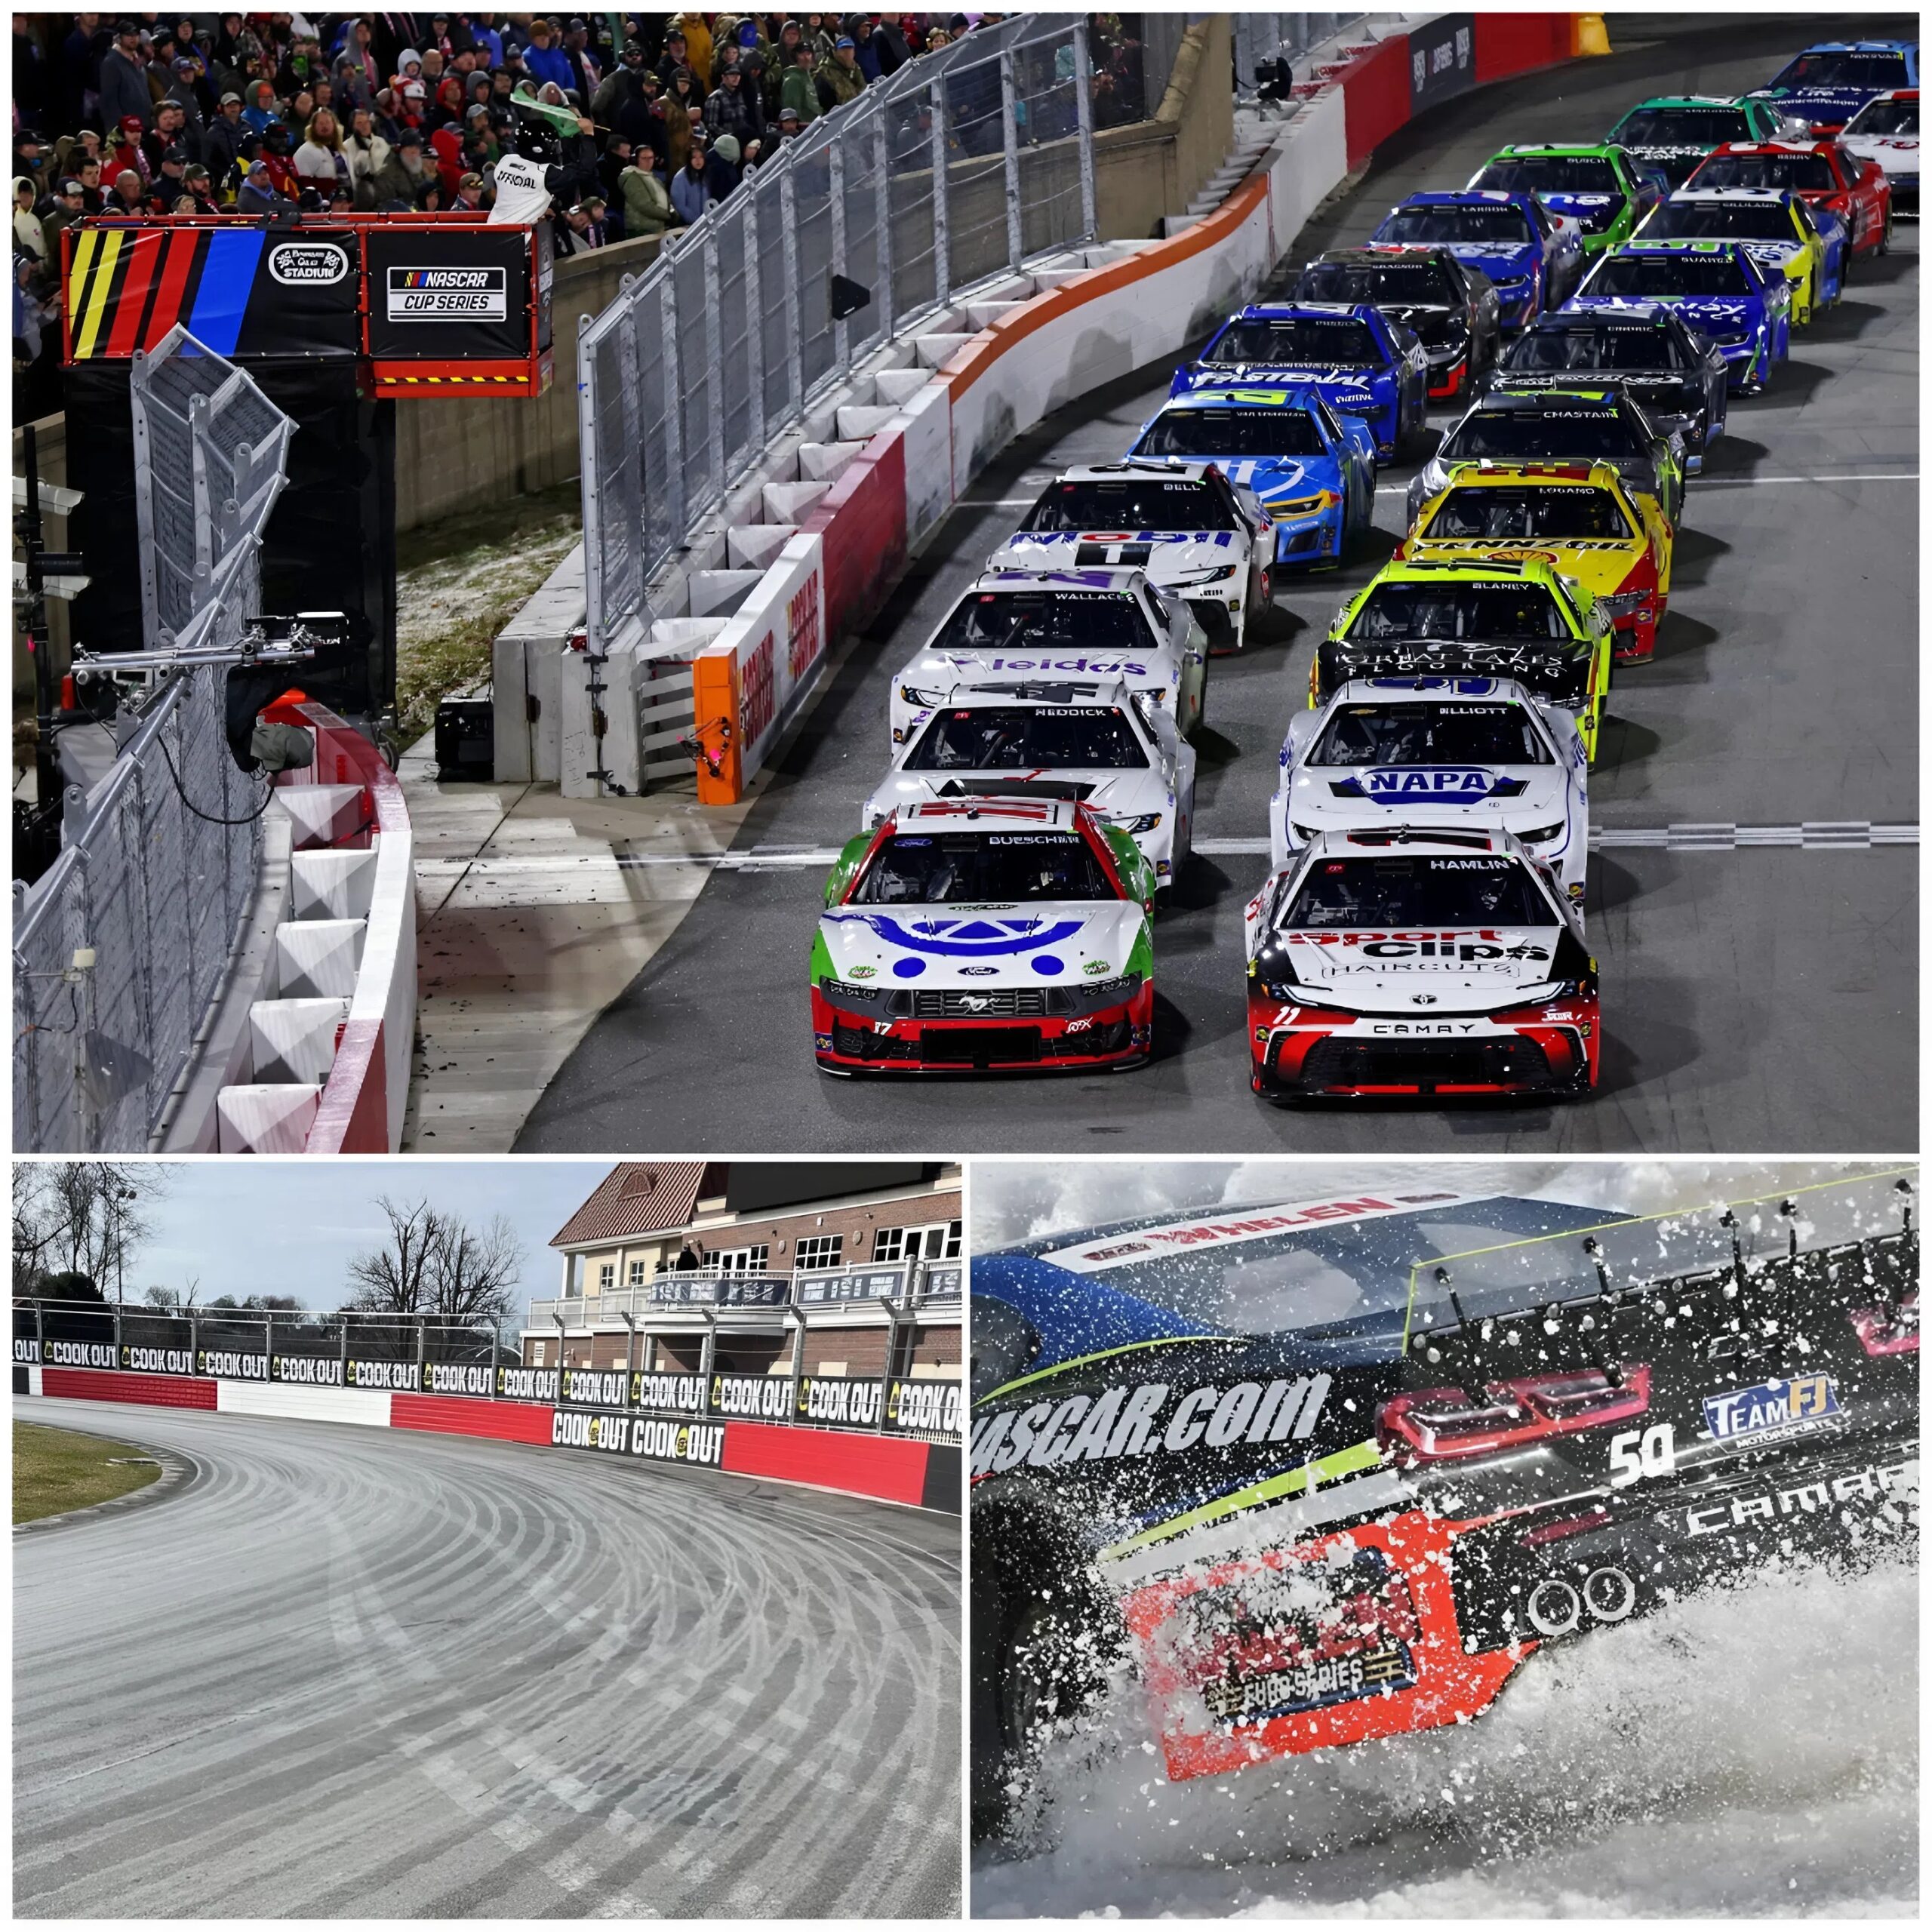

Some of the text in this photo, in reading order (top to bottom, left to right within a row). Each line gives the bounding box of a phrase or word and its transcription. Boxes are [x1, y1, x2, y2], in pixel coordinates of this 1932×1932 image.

[283, 267, 334, 278] STADIUM
[425, 272, 488, 287] NASCAR
[405, 295, 490, 309] CUP SERIES
[1370, 771, 1488, 792] NAPA
[1431, 860, 1509, 870] HAMLIN
[1332, 964, 1510, 976] HAIRCUTS
[874, 1021, 892, 1035] 17
[1273, 1006, 1302, 1024] 11
[1146, 1197, 1396, 1244] WHELEN
[54, 1341, 116, 1367] COOK OUT
[131, 1347, 192, 1374] COOK OUT
[206, 1351, 267, 1380] COOK OUT
[281, 1357, 341, 1384] COOK OUT
[355, 1361, 418, 1389] COOK OUT
[432, 1364, 493, 1393] COOK OUT
[504, 1369, 558, 1398] COOK OUT
[570, 1372, 627, 1404] COOK OUT
[640, 1375, 706, 1410] COOK OUT
[721, 1378, 792, 1417] COOK OUT
[808, 1380, 883, 1423] COOK OUT
[897, 1383, 945, 1431] COOK
[552, 1412, 724, 1464] COOK OUT COOK OUT
[1294, 1657, 1364, 1703] SERIES
